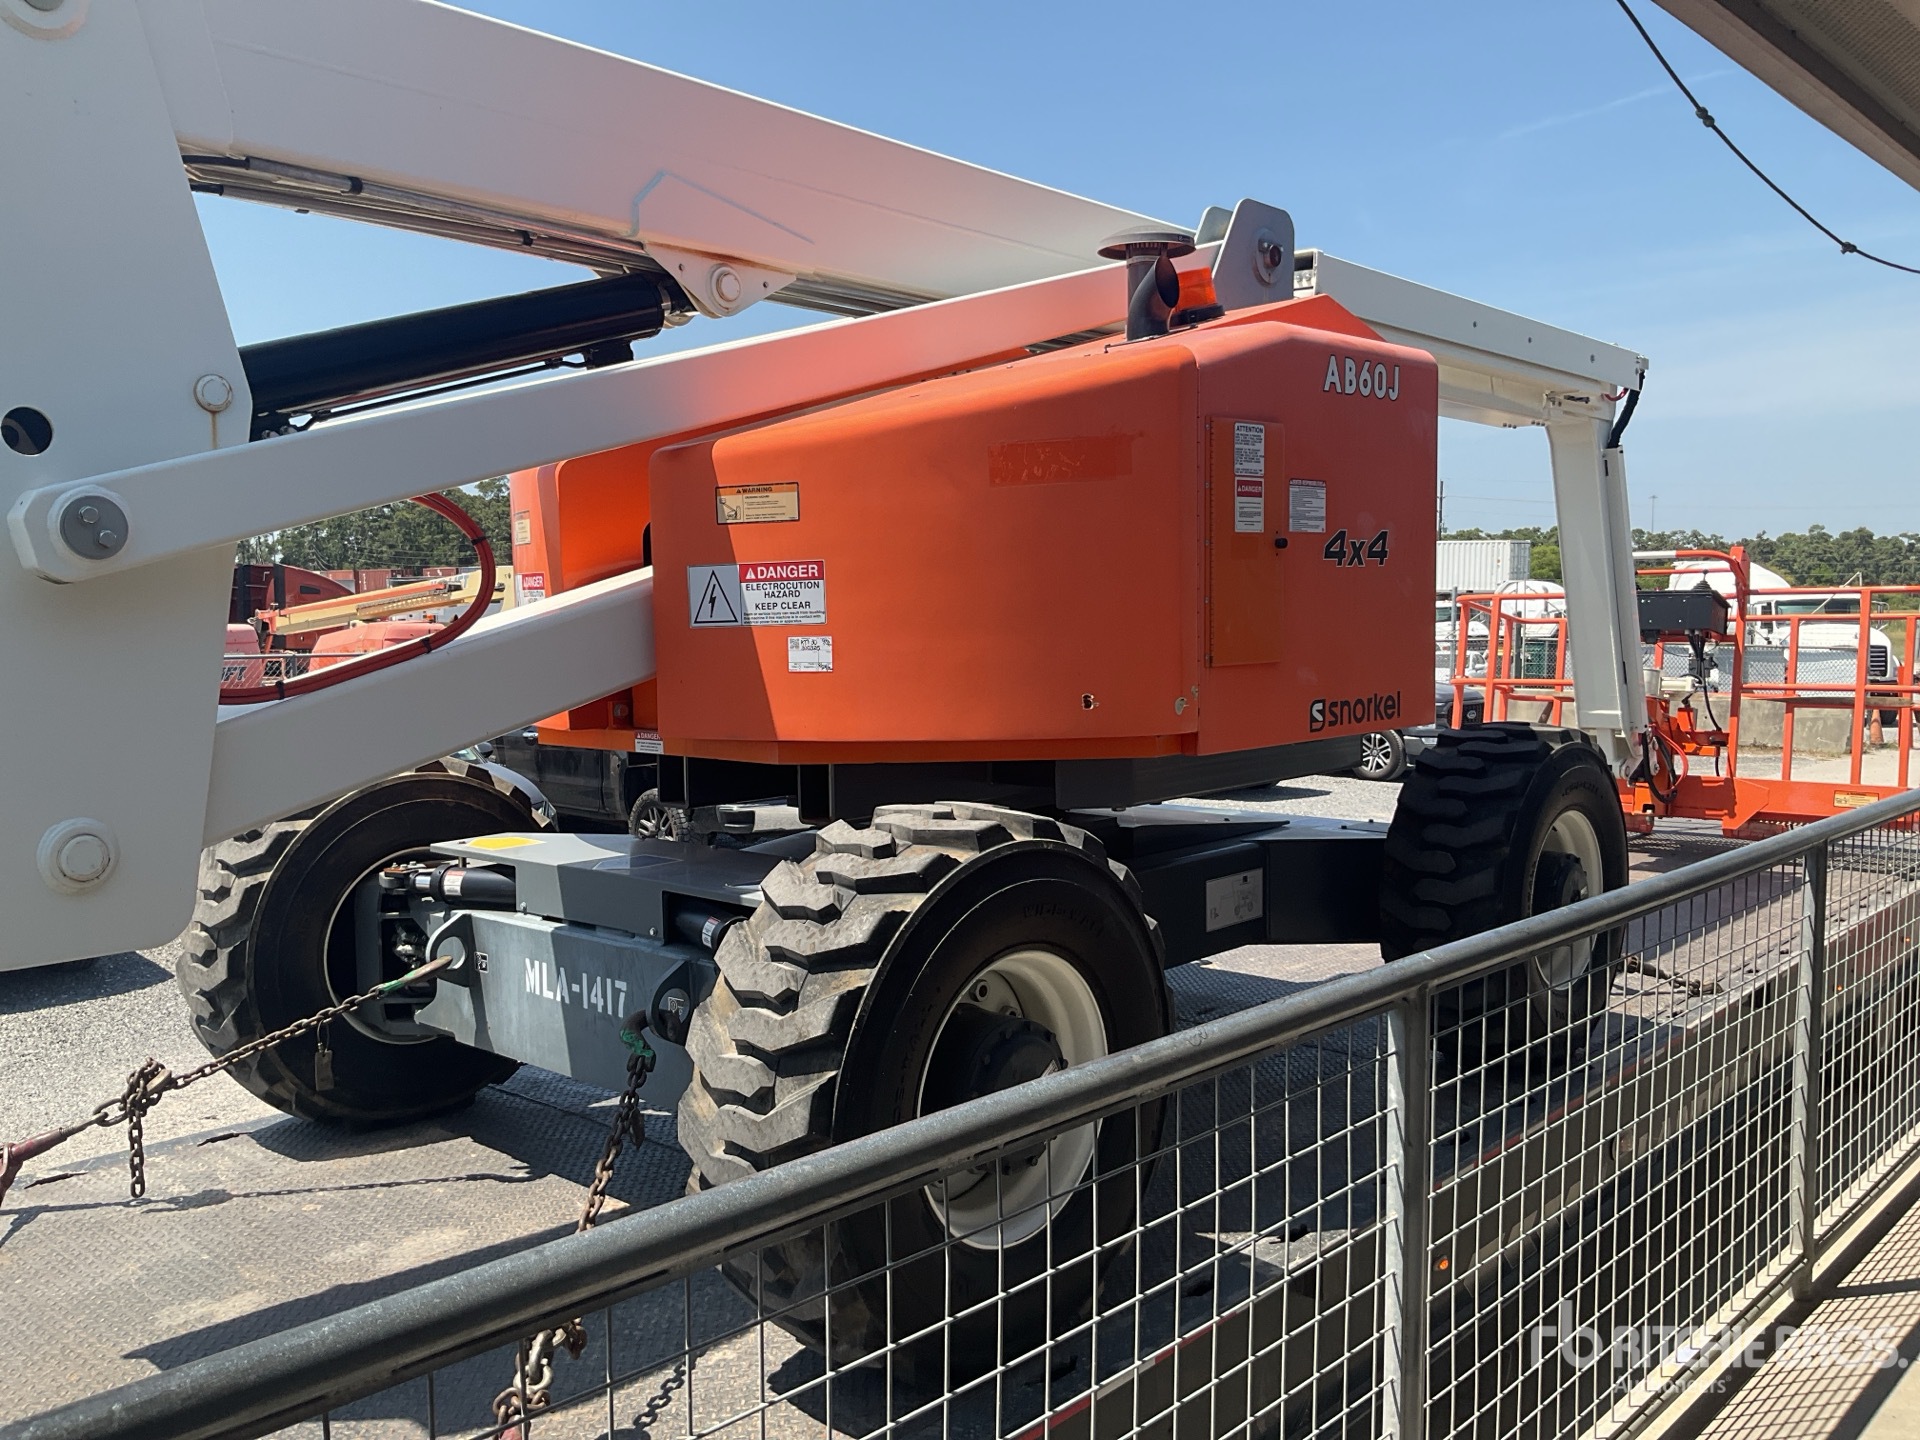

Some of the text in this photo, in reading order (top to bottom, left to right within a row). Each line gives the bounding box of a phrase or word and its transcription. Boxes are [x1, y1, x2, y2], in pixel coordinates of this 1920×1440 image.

[1323, 354, 1400, 401] AB60J
[1236, 425, 1264, 433] ATTENTION
[742, 486, 773, 494] WARNING
[1241, 485, 1262, 493] DANGER
[1323, 529, 1389, 567] 4x4
[757, 564, 819, 580] DANGER
[524, 576, 544, 587] DANGER
[745, 580, 820, 592] ELECTROCUTION
[764, 589, 801, 599] HAZARD
[755, 601, 811, 611] KEEP CLEAR
[1328, 691, 1400, 727] snorkel
[525, 957, 627, 1018] MLA-1417
